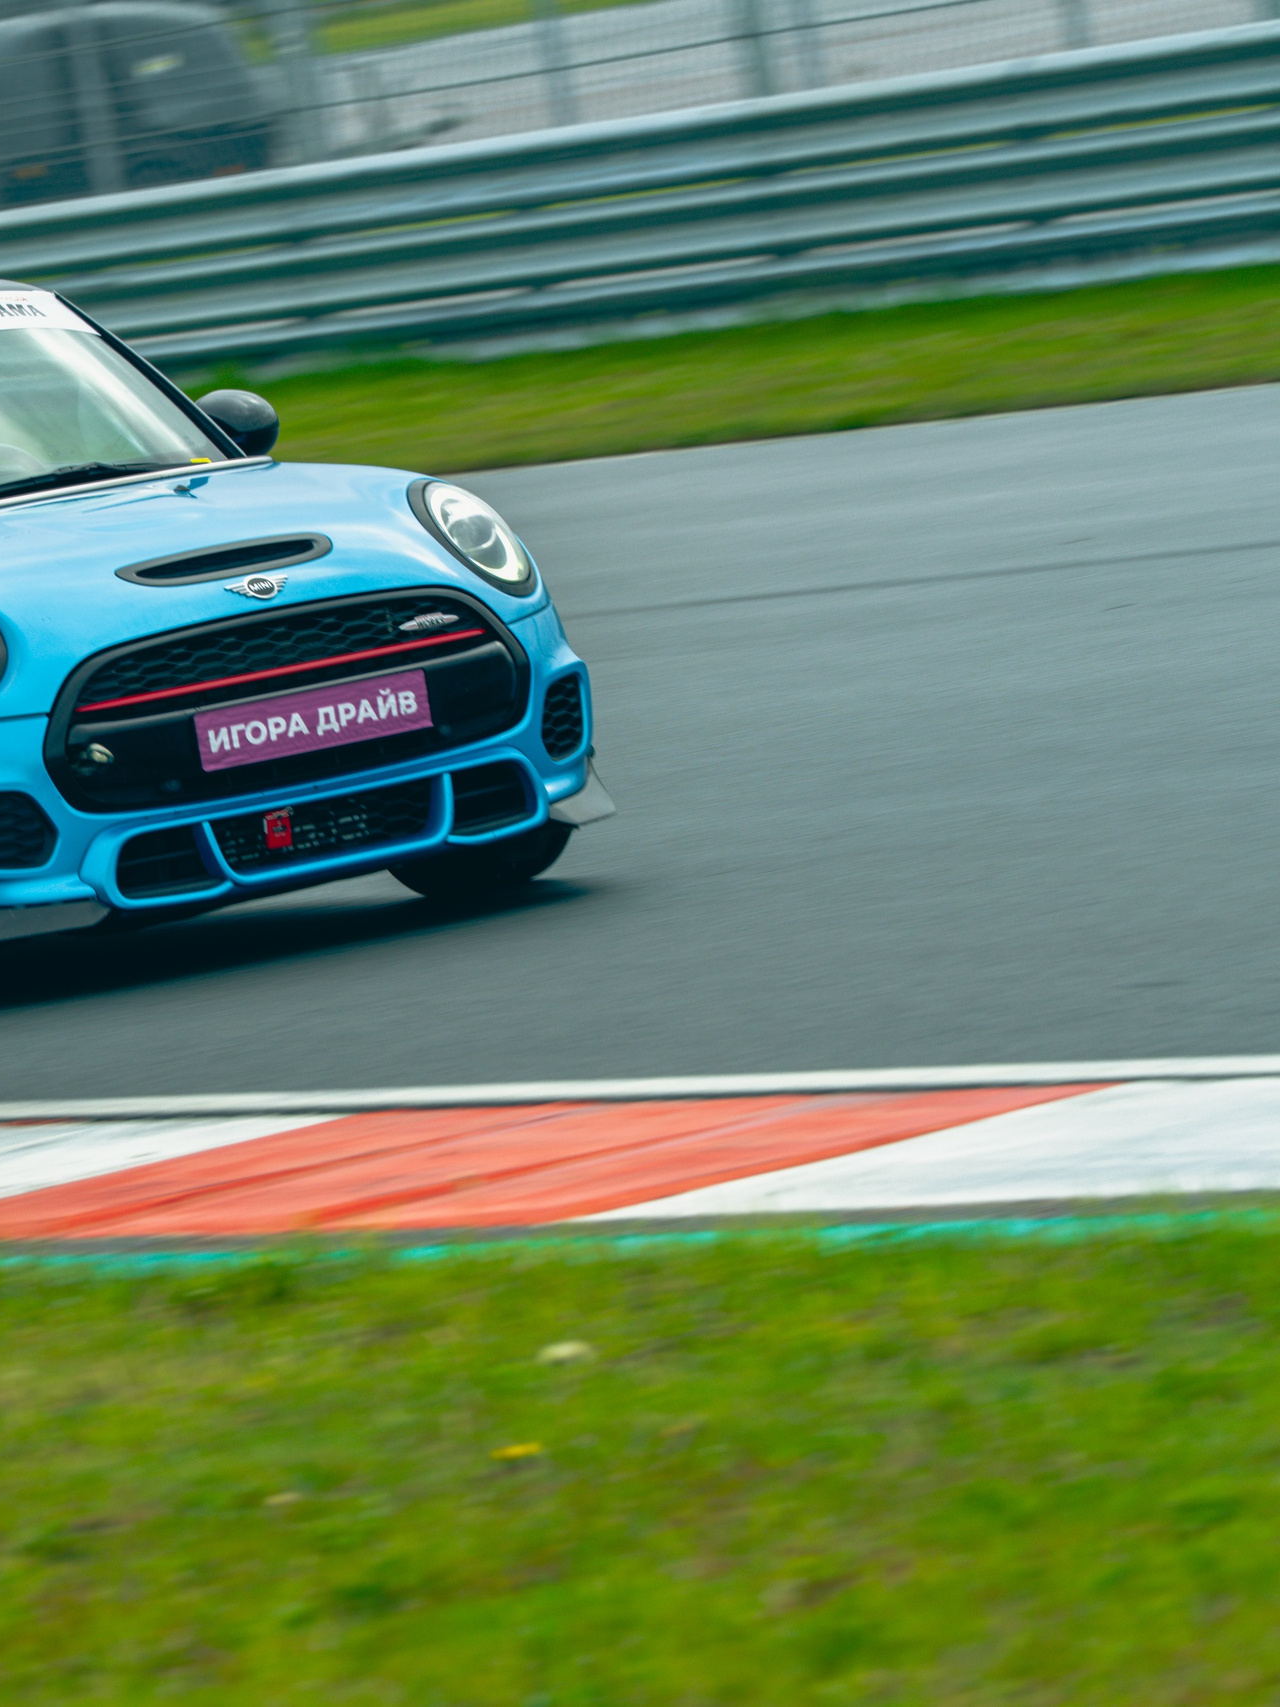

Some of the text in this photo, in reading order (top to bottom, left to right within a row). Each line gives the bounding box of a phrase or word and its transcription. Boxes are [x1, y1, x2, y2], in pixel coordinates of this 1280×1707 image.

[248, 580, 273, 592] MINI
[207, 688, 418, 753] ИГОРА ДРАЙВ
